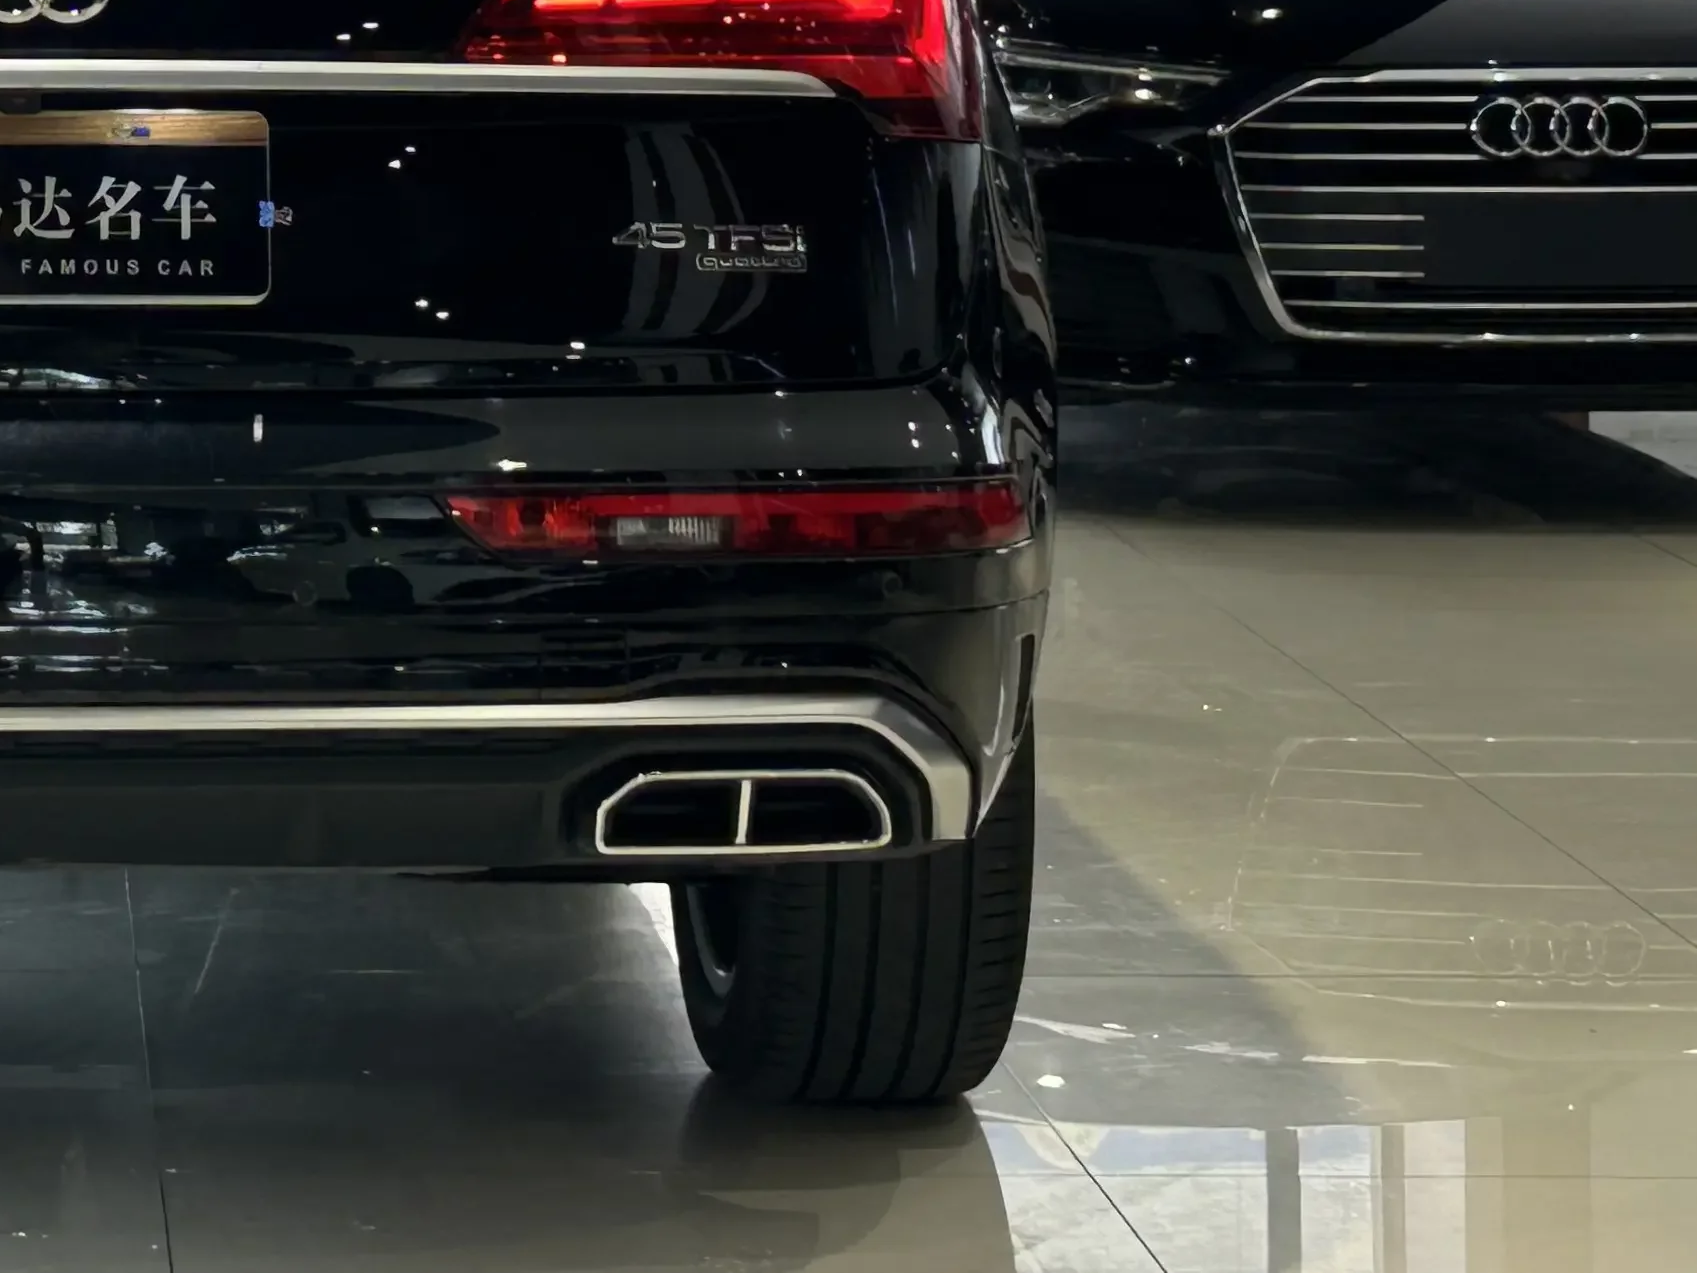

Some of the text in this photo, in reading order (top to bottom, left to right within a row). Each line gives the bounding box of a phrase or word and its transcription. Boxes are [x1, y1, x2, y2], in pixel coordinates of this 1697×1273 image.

[612, 222, 686, 249] 45
[21, 259, 140, 276] FAMOUS
[157, 259, 214, 276] CAR
